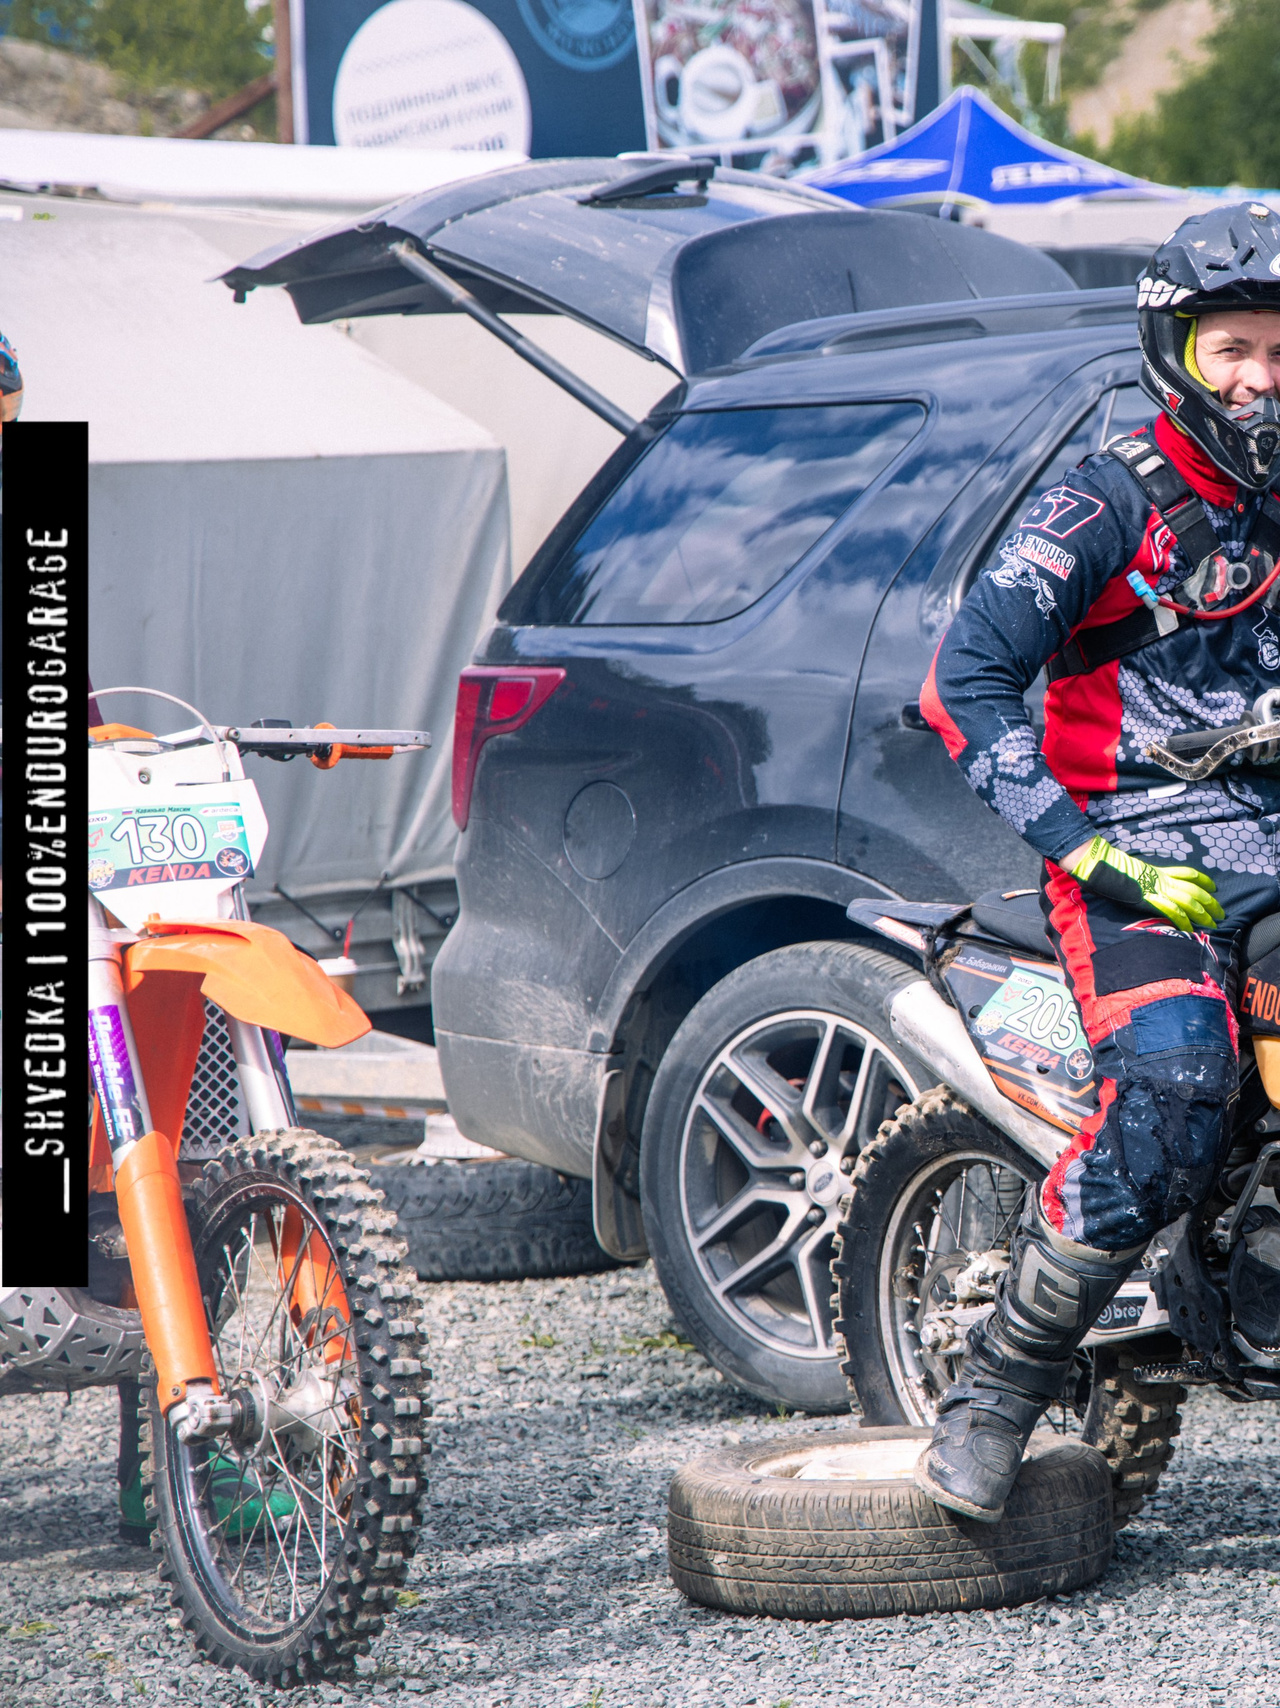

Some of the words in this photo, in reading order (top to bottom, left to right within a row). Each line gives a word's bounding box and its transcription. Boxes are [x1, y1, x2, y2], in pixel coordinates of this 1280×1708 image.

[1019, 547, 1070, 579] GENTLEMEN
[1024, 535, 1075, 571] ENDURO
[111, 814, 206, 865] 130
[127, 863, 211, 886] KENDA
[966, 956, 1008, 973] Бабарыкин
[1004, 986, 1078, 1050] 205
[91, 1014, 125, 1101] Double
[997, 1032, 1062, 1070] KENDA
[93, 1064, 115, 1141] Suspension
